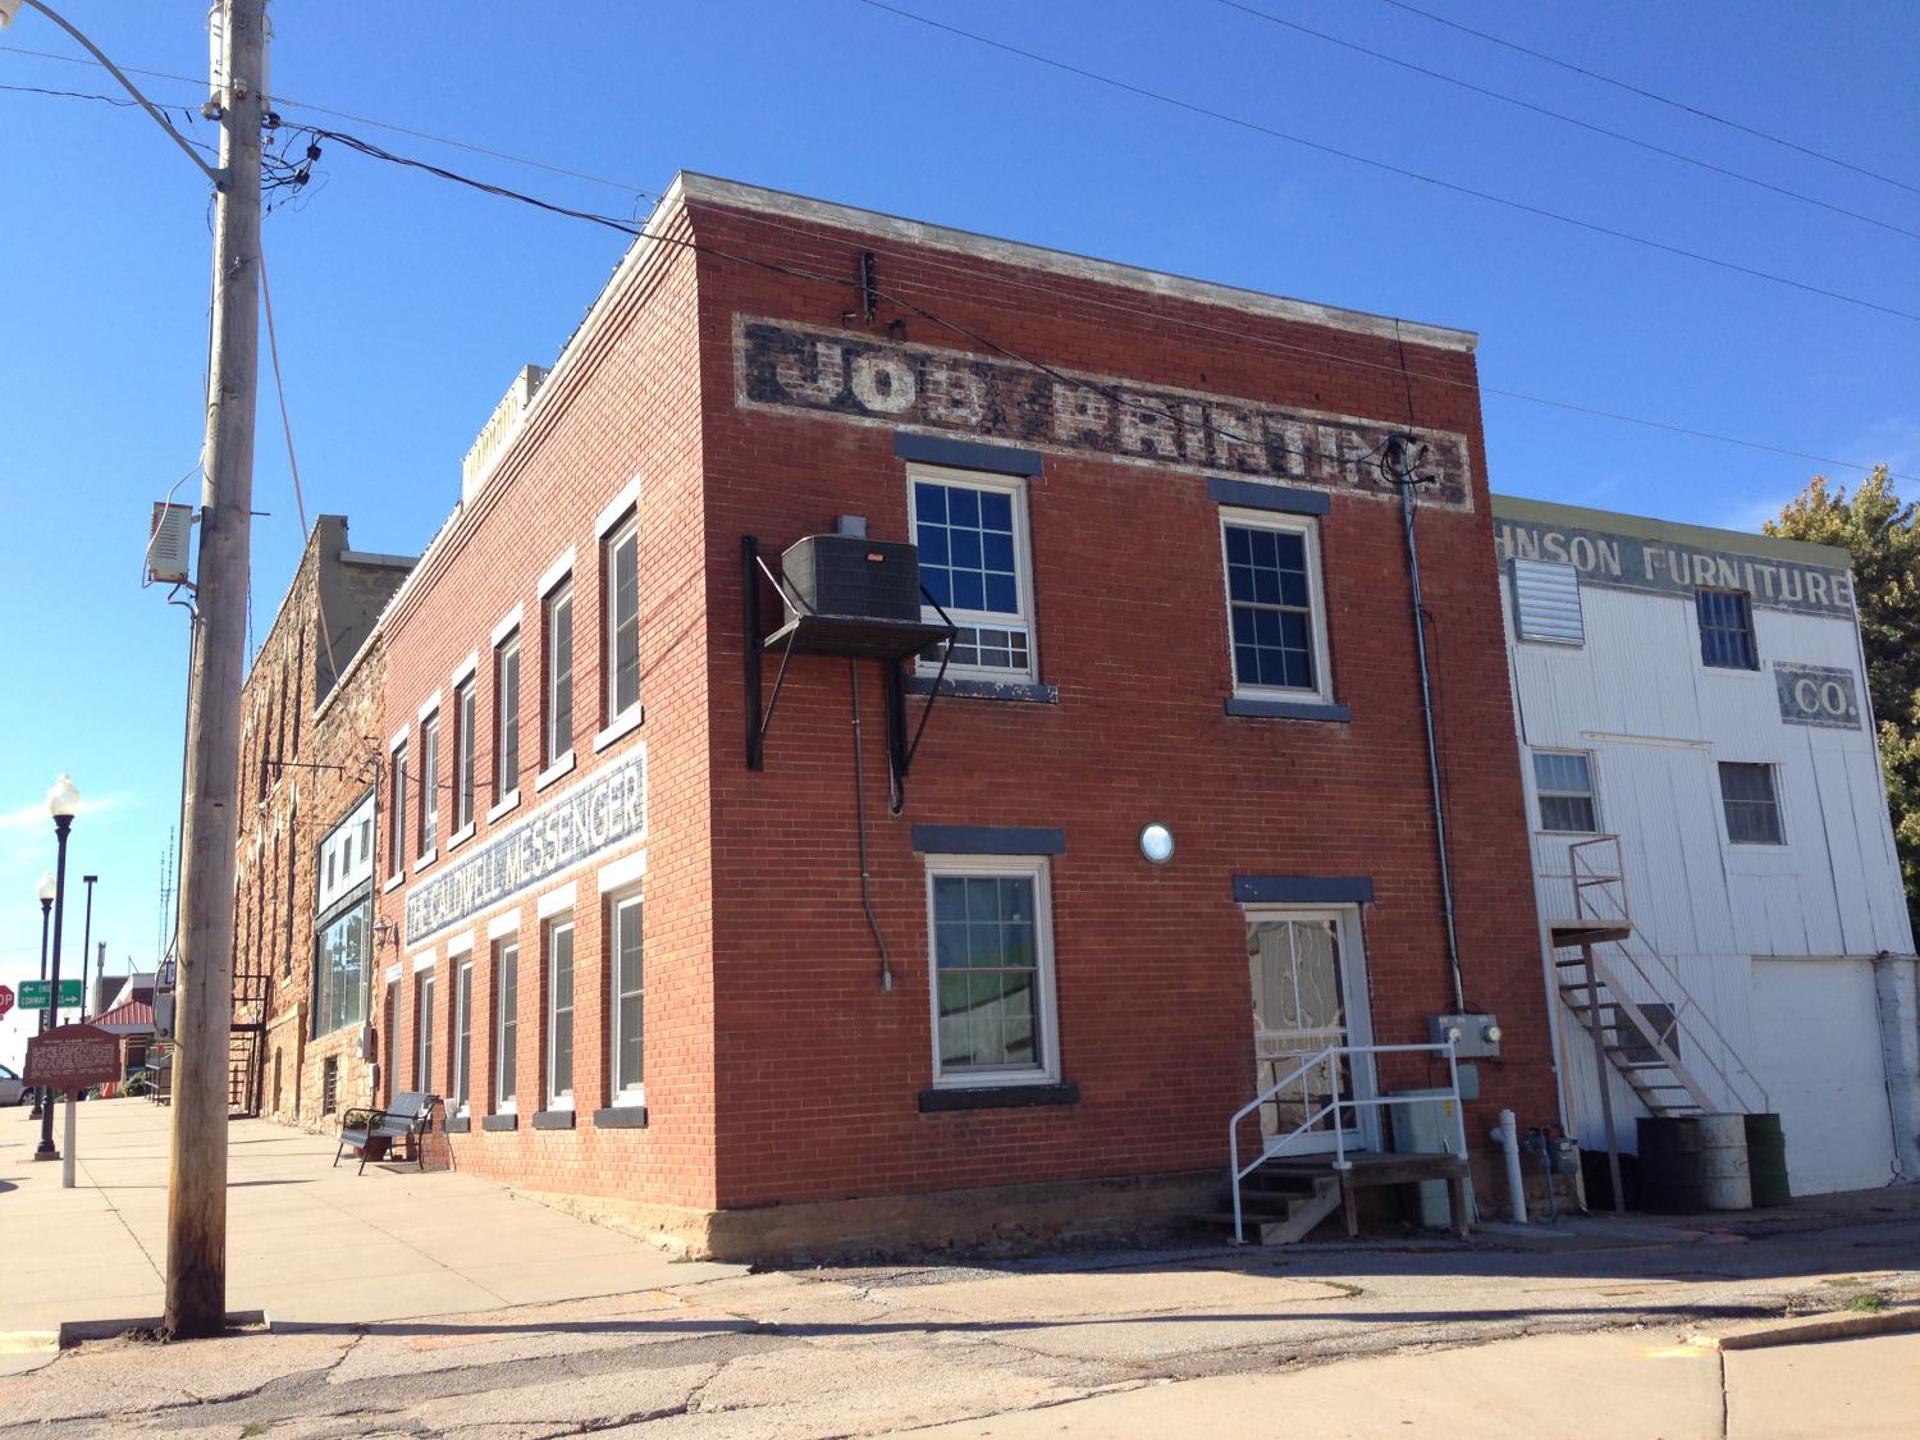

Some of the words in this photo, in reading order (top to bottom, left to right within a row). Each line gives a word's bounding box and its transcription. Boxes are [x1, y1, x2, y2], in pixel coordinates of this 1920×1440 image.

[776, 341, 988, 427] JOB
[1052, 380, 1446, 492] PRINTING
[1642, 546, 1853, 608] FURNITURE
[1794, 678, 1858, 717] CO.
[430, 850, 502, 929] CALDWELL
[505, 765, 640, 891] MESSENGER
